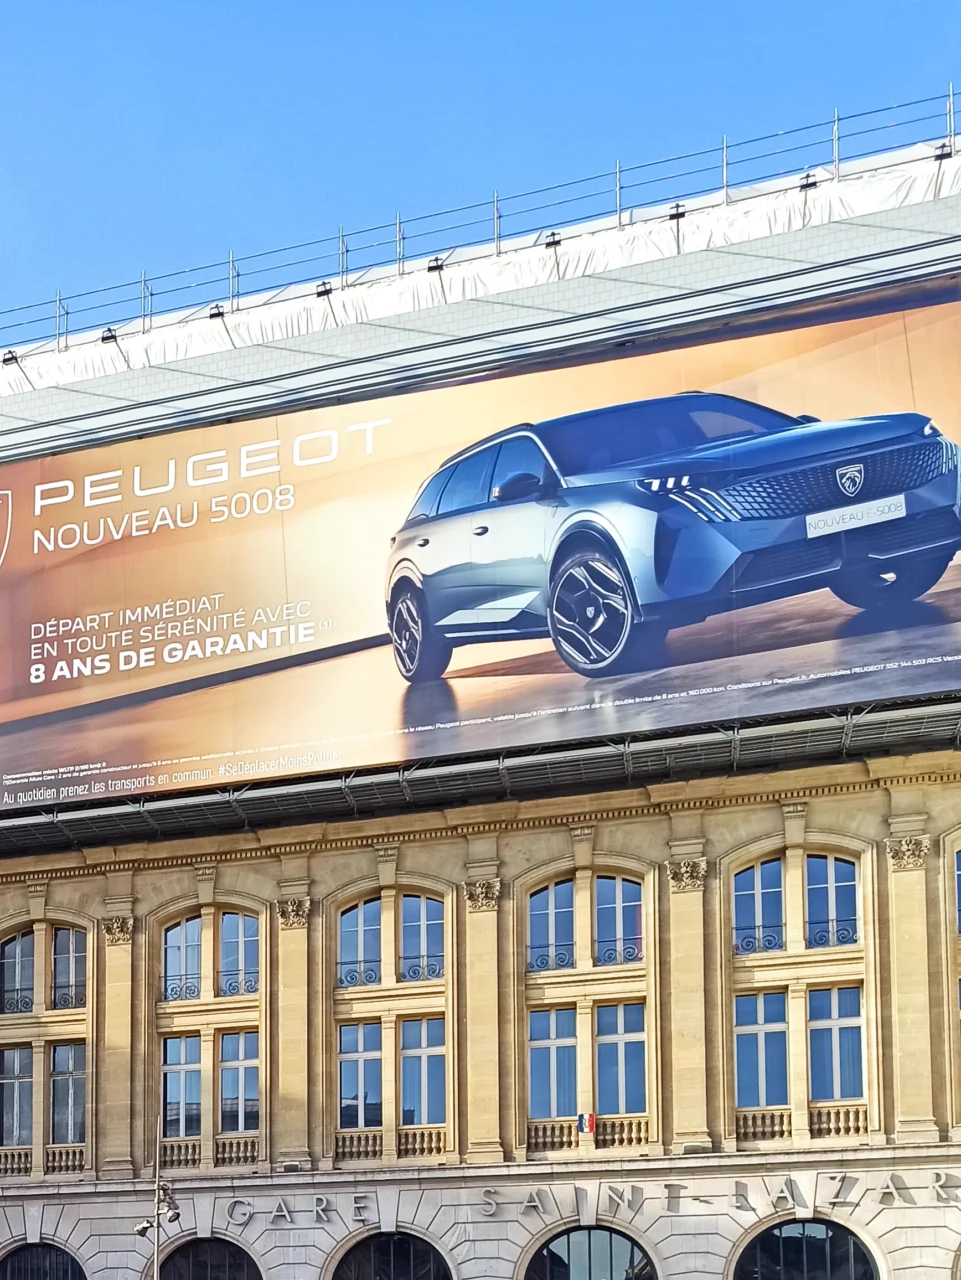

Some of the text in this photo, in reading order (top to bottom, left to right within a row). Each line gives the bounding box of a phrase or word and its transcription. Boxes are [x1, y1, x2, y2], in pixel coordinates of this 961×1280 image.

[34, 418, 392, 516] PEUGEOT
[33, 483, 295, 554] NOUVEAU 5008
[808, 509, 864, 531] NOUVEAU
[30, 600, 312, 660] EN TOUTE SÉRÉNITÉ AVEC
[31, 593, 225, 640] DÉPART IMMÉDIAT
[29, 663, 45, 684] 8
[51, 656, 111, 682] ANS
[118, 646, 155, 672] DE
[161, 620, 316, 667] GARANTIE
[435, 720, 460, 730] Peugeot
[851, 664, 885, 674] PEUGEOT
[2, 791, 15, 804] Au
[17, 787, 57, 805] quotidien
[59, 784, 89, 800] prenez
[91, 781, 105, 793] les
[108, 775, 156, 793] transports
[157, 775, 169, 784] en
[172, 767, 215, 784] commun.
[226, 1193, 368, 1226] GARE
